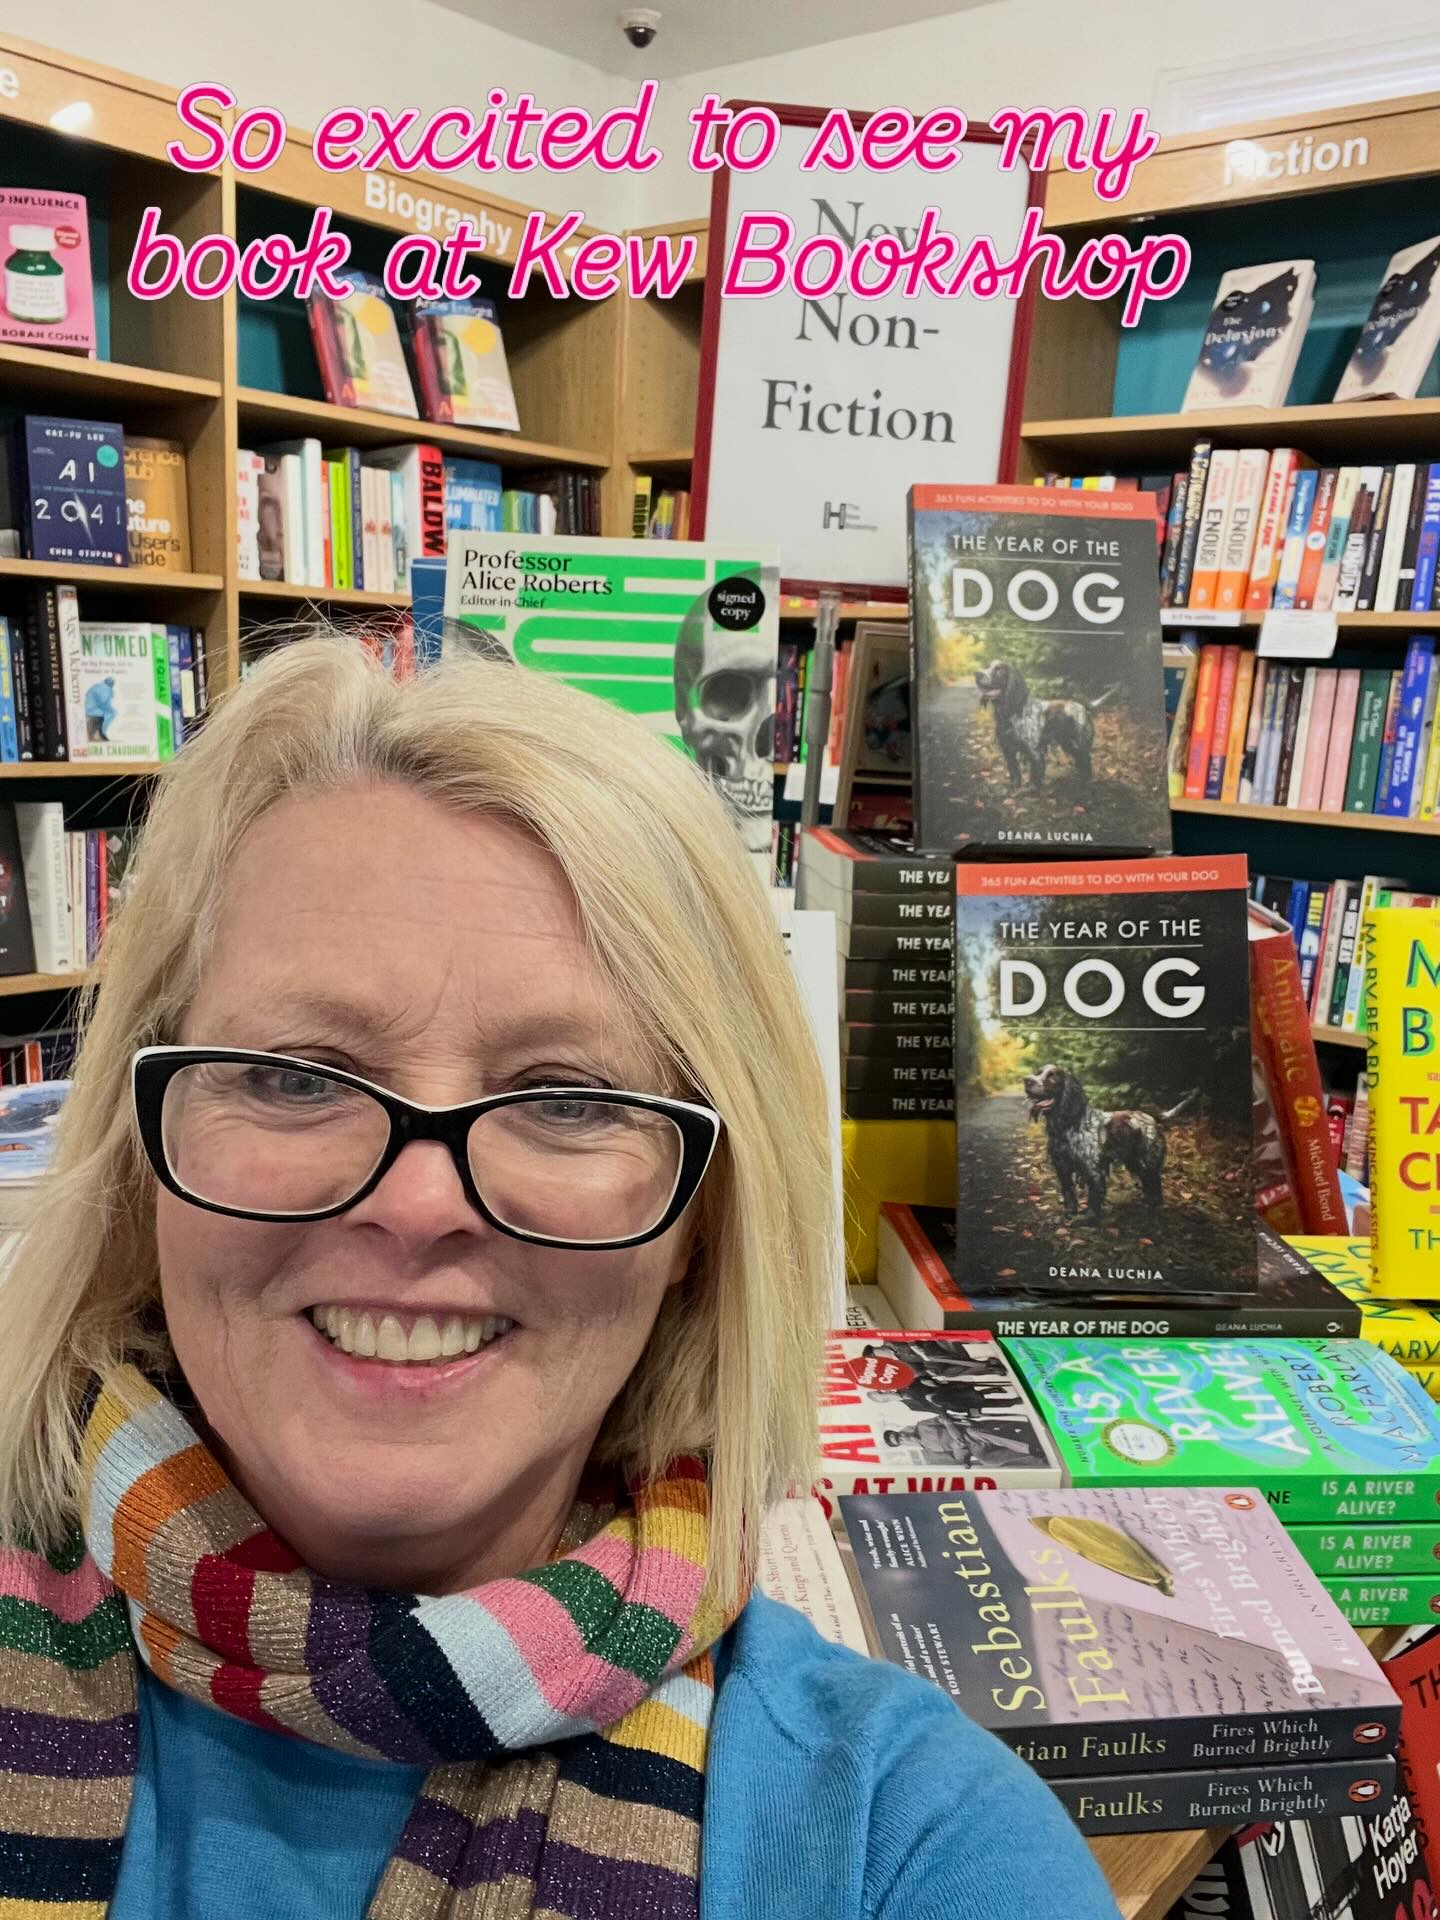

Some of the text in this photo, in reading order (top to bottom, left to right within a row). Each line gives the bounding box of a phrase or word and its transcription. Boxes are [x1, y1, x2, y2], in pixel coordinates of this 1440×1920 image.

[795, 292, 940, 350] Non-
[761, 378, 957, 444] Fiction
[952, 534, 1120, 557] THE YEAR OF THE
[463, 549, 573, 572] Professor
[461, 572, 613, 596] Alice Roberts
[717, 591, 756, 605] signed
[952, 568, 1125, 624] DOG
[720, 603, 752, 619] copy
[998, 830, 1093, 843] DEANA LUCHIA
[899, 871, 925, 884] THE
[1004, 875, 1027, 887] FUN
[1029, 874, 1085, 886] ACTIVITIES
[1087, 874, 1102, 885] TO
[1104, 873, 1122, 885] DO
[1126, 872, 1154, 883] WITH
[1158, 871, 1188, 882] YOUR
[1191, 870, 1219, 881] DOG
[898, 905, 924, 917] THE
[1000, 919, 1201, 939] THE YEAR OF THE
[897, 938, 922, 950] THE
[892, 969, 916, 981] THE
[1000, 957, 1206, 1019] DOG
[892, 1002, 916, 1014] THE
[897, 1036, 921, 1048] THE
[1366, 1007, 1380, 1090] BEARD
[893, 1068, 917, 1080] THE
[892, 1099, 916, 1111] THE
[1306, 1138, 1328, 1189] Michael
[1316, 1182, 1337, 1222] Bond
[1048, 1265, 1165, 1281] DEANA LUCHIA
[997, 1319, 1170, 1335] THE YEAR OF THE DOG
[1215, 1323, 1247, 1332] DEANA
[858, 1357, 878, 1385] Signed
[878, 1363, 899, 1385] Copy
[1056, 1356, 1121, 1424] IS A
[1121, 1347, 1220, 1441] RIVER
[1187, 1341, 1312, 1456] ALIVE?
[1280, 1354, 1358, 1427] ROBERT
[1322, 1480, 1415, 1496] IS A RIVER
[1336, 1500, 1396, 1516] ALIVE?
[891, 1518, 916, 1567] ALICE WINN
[1320, 1535, 1412, 1550] IS A RIVER
[1143, 1495, 1248, 1638] Fires Which
[1335, 1555, 1395, 1570] ALIVE?
[937, 1500, 1047, 1712] Sebastian
[1186, 1495, 1327, 1697] Burned Brightly
[1341, 1589, 1357, 1602] A
[1361, 1588, 1409, 1602] RIVER
[1024, 1548, 1131, 1709] Faulks
[927, 1622, 960, 1696] RORY STEWART
[1212, 1717, 1319, 1739] Fires Which
[1081, 1732, 1168, 1758] Faulks
[1192, 1735, 1334, 1758] Burned Brightly
[1207, 1775, 1314, 1798] Fires Which
[1078, 1793, 1164, 1820] Faulks
[1189, 1794, 1329, 1818] Burned Brightly
[1369, 1794, 1412, 1857] Katja
[1373, 1828, 1419, 1900] Hoyer
